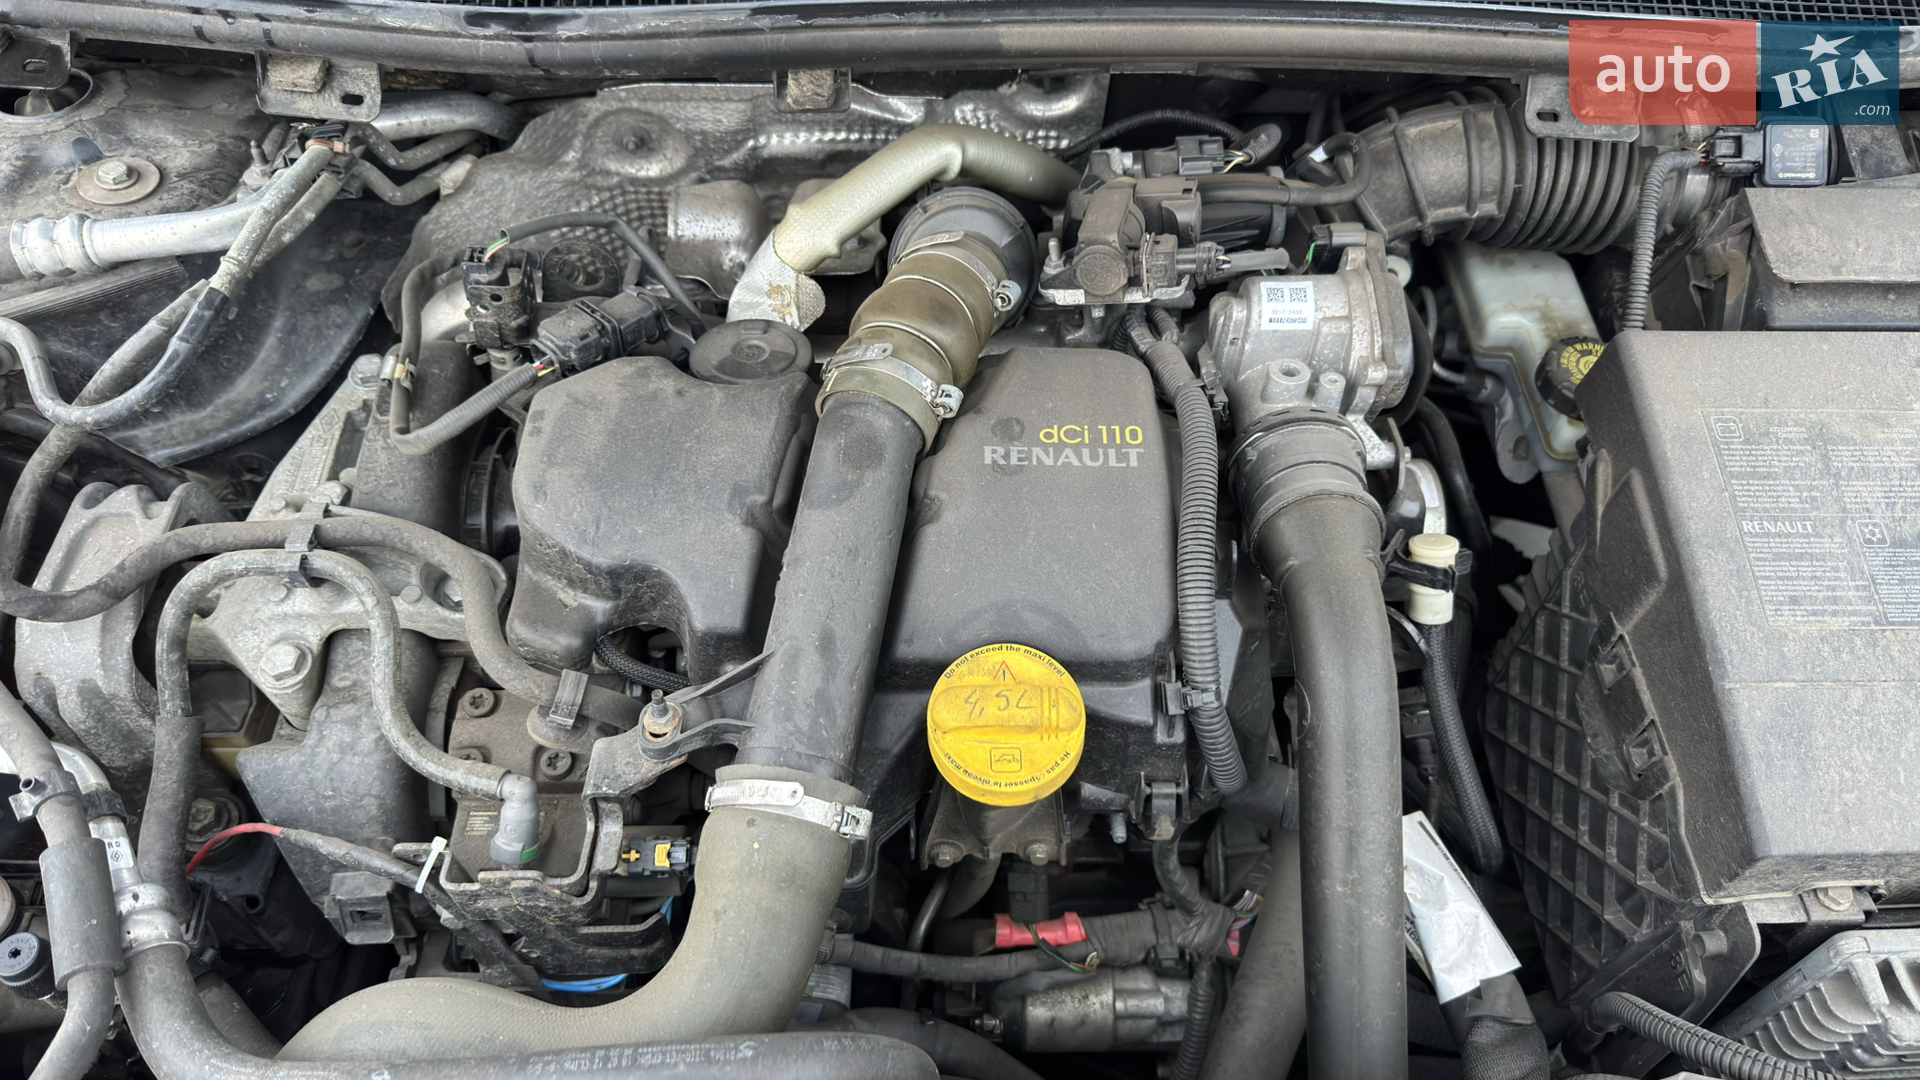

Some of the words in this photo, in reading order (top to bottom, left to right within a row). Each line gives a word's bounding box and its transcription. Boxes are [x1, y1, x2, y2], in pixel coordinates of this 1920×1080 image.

[1039, 424, 1090, 444] dCi
[1098, 425, 1143, 445] 110
[983, 445, 1144, 467] RENAULT
[1741, 520, 1814, 533] RENAULT
[944, 668, 955, 679] Do
[955, 657, 969, 670] not
[970, 645, 1003, 659] exceed
[1024, 648, 1046, 662] maxi
[1046, 659, 1066, 677] level
[944, 752, 962, 770] maxi
[1046, 761, 1060, 775] pas
[962, 769, 991, 786] niveau
